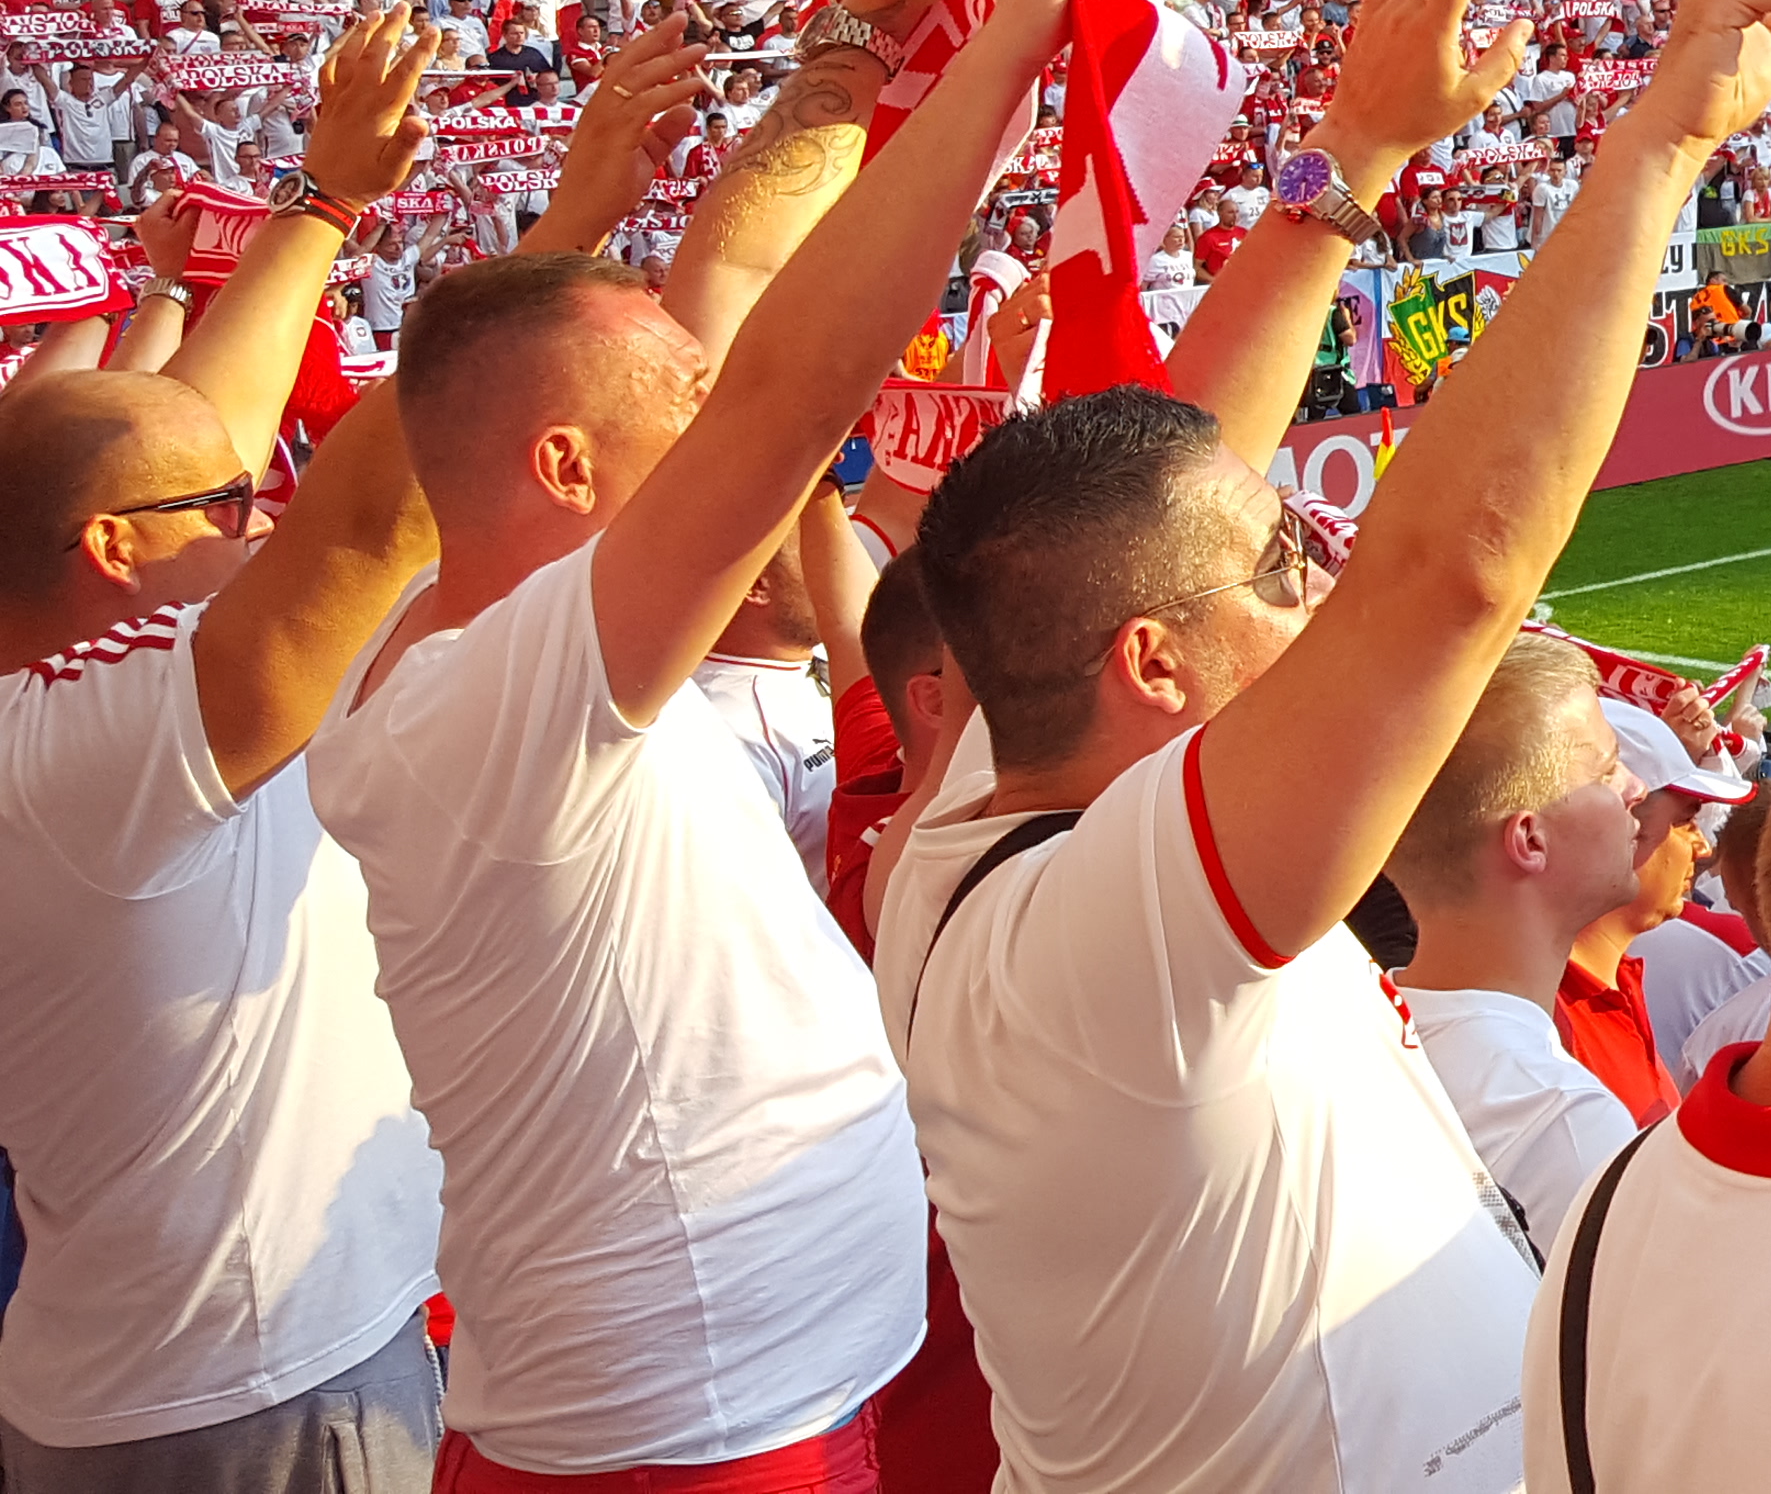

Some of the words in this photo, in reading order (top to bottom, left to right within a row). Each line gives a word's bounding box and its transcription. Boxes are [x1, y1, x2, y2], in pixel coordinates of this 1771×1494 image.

[1572, 1, 1616, 16] POLSKA
[188, 64, 286, 88] POLSKA
[443, 116, 518, 131] POLSKA
[1406, 292, 1468, 361] GKS
